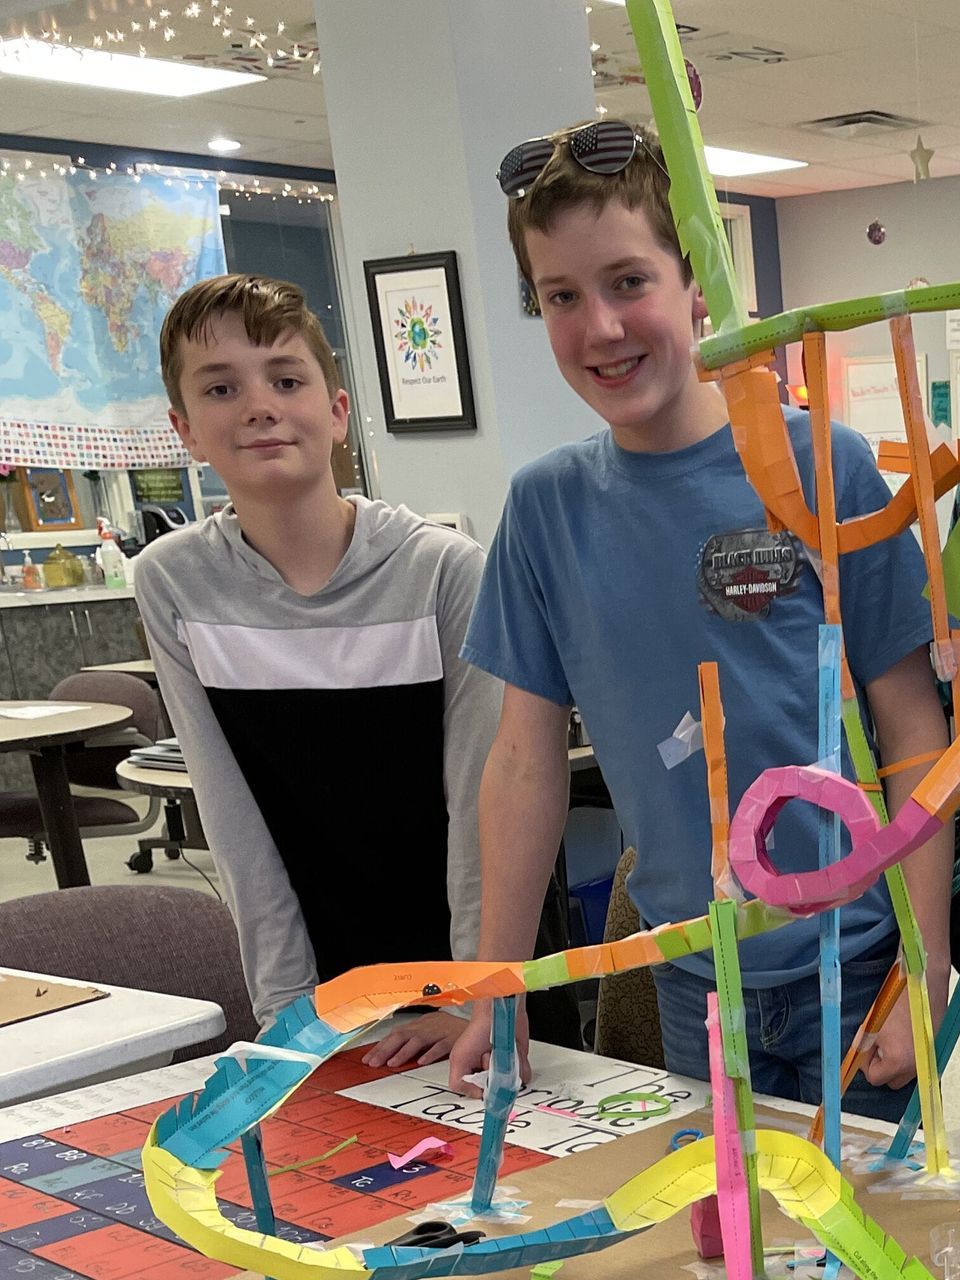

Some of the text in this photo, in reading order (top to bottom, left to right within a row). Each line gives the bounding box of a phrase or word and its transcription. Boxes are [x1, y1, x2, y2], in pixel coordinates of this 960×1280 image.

[422, 375, 433, 385] Our
[433, 375, 447, 384] Earth
[725, 581, 778, 597] HARLEY-DAVIDSON
[21, 1138, 57, 1151] 87
[55, 1149, 88, 1161] 88
[351, 1175, 375, 1189] Tc
[853, 1250, 862, 1261] Cut
[860, 1259, 872, 1274] along
[869, 1270, 879, 1280] the
